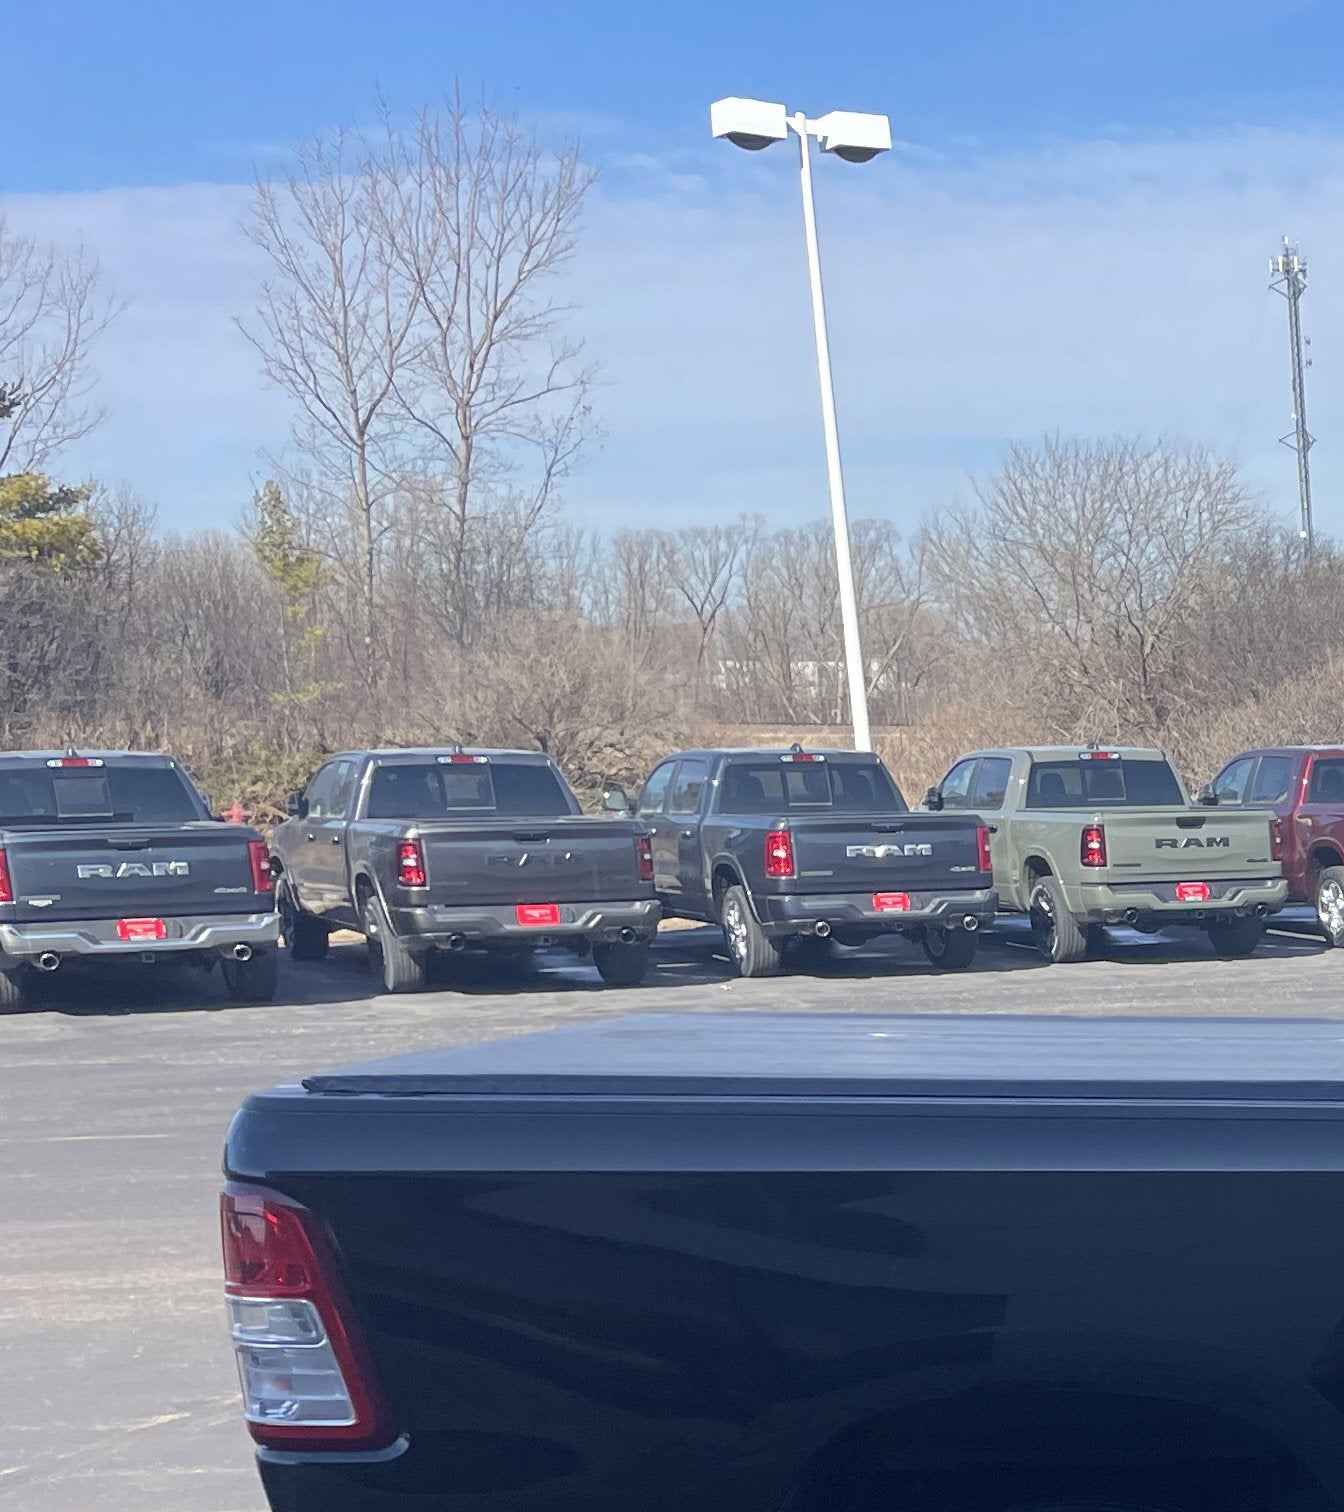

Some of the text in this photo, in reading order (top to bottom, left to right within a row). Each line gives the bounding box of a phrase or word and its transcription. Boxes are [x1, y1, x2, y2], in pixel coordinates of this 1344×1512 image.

[1155, 837, 1230, 848] RAM
[846, 844, 932, 857] RAM
[76, 861, 190, 879] RAM
